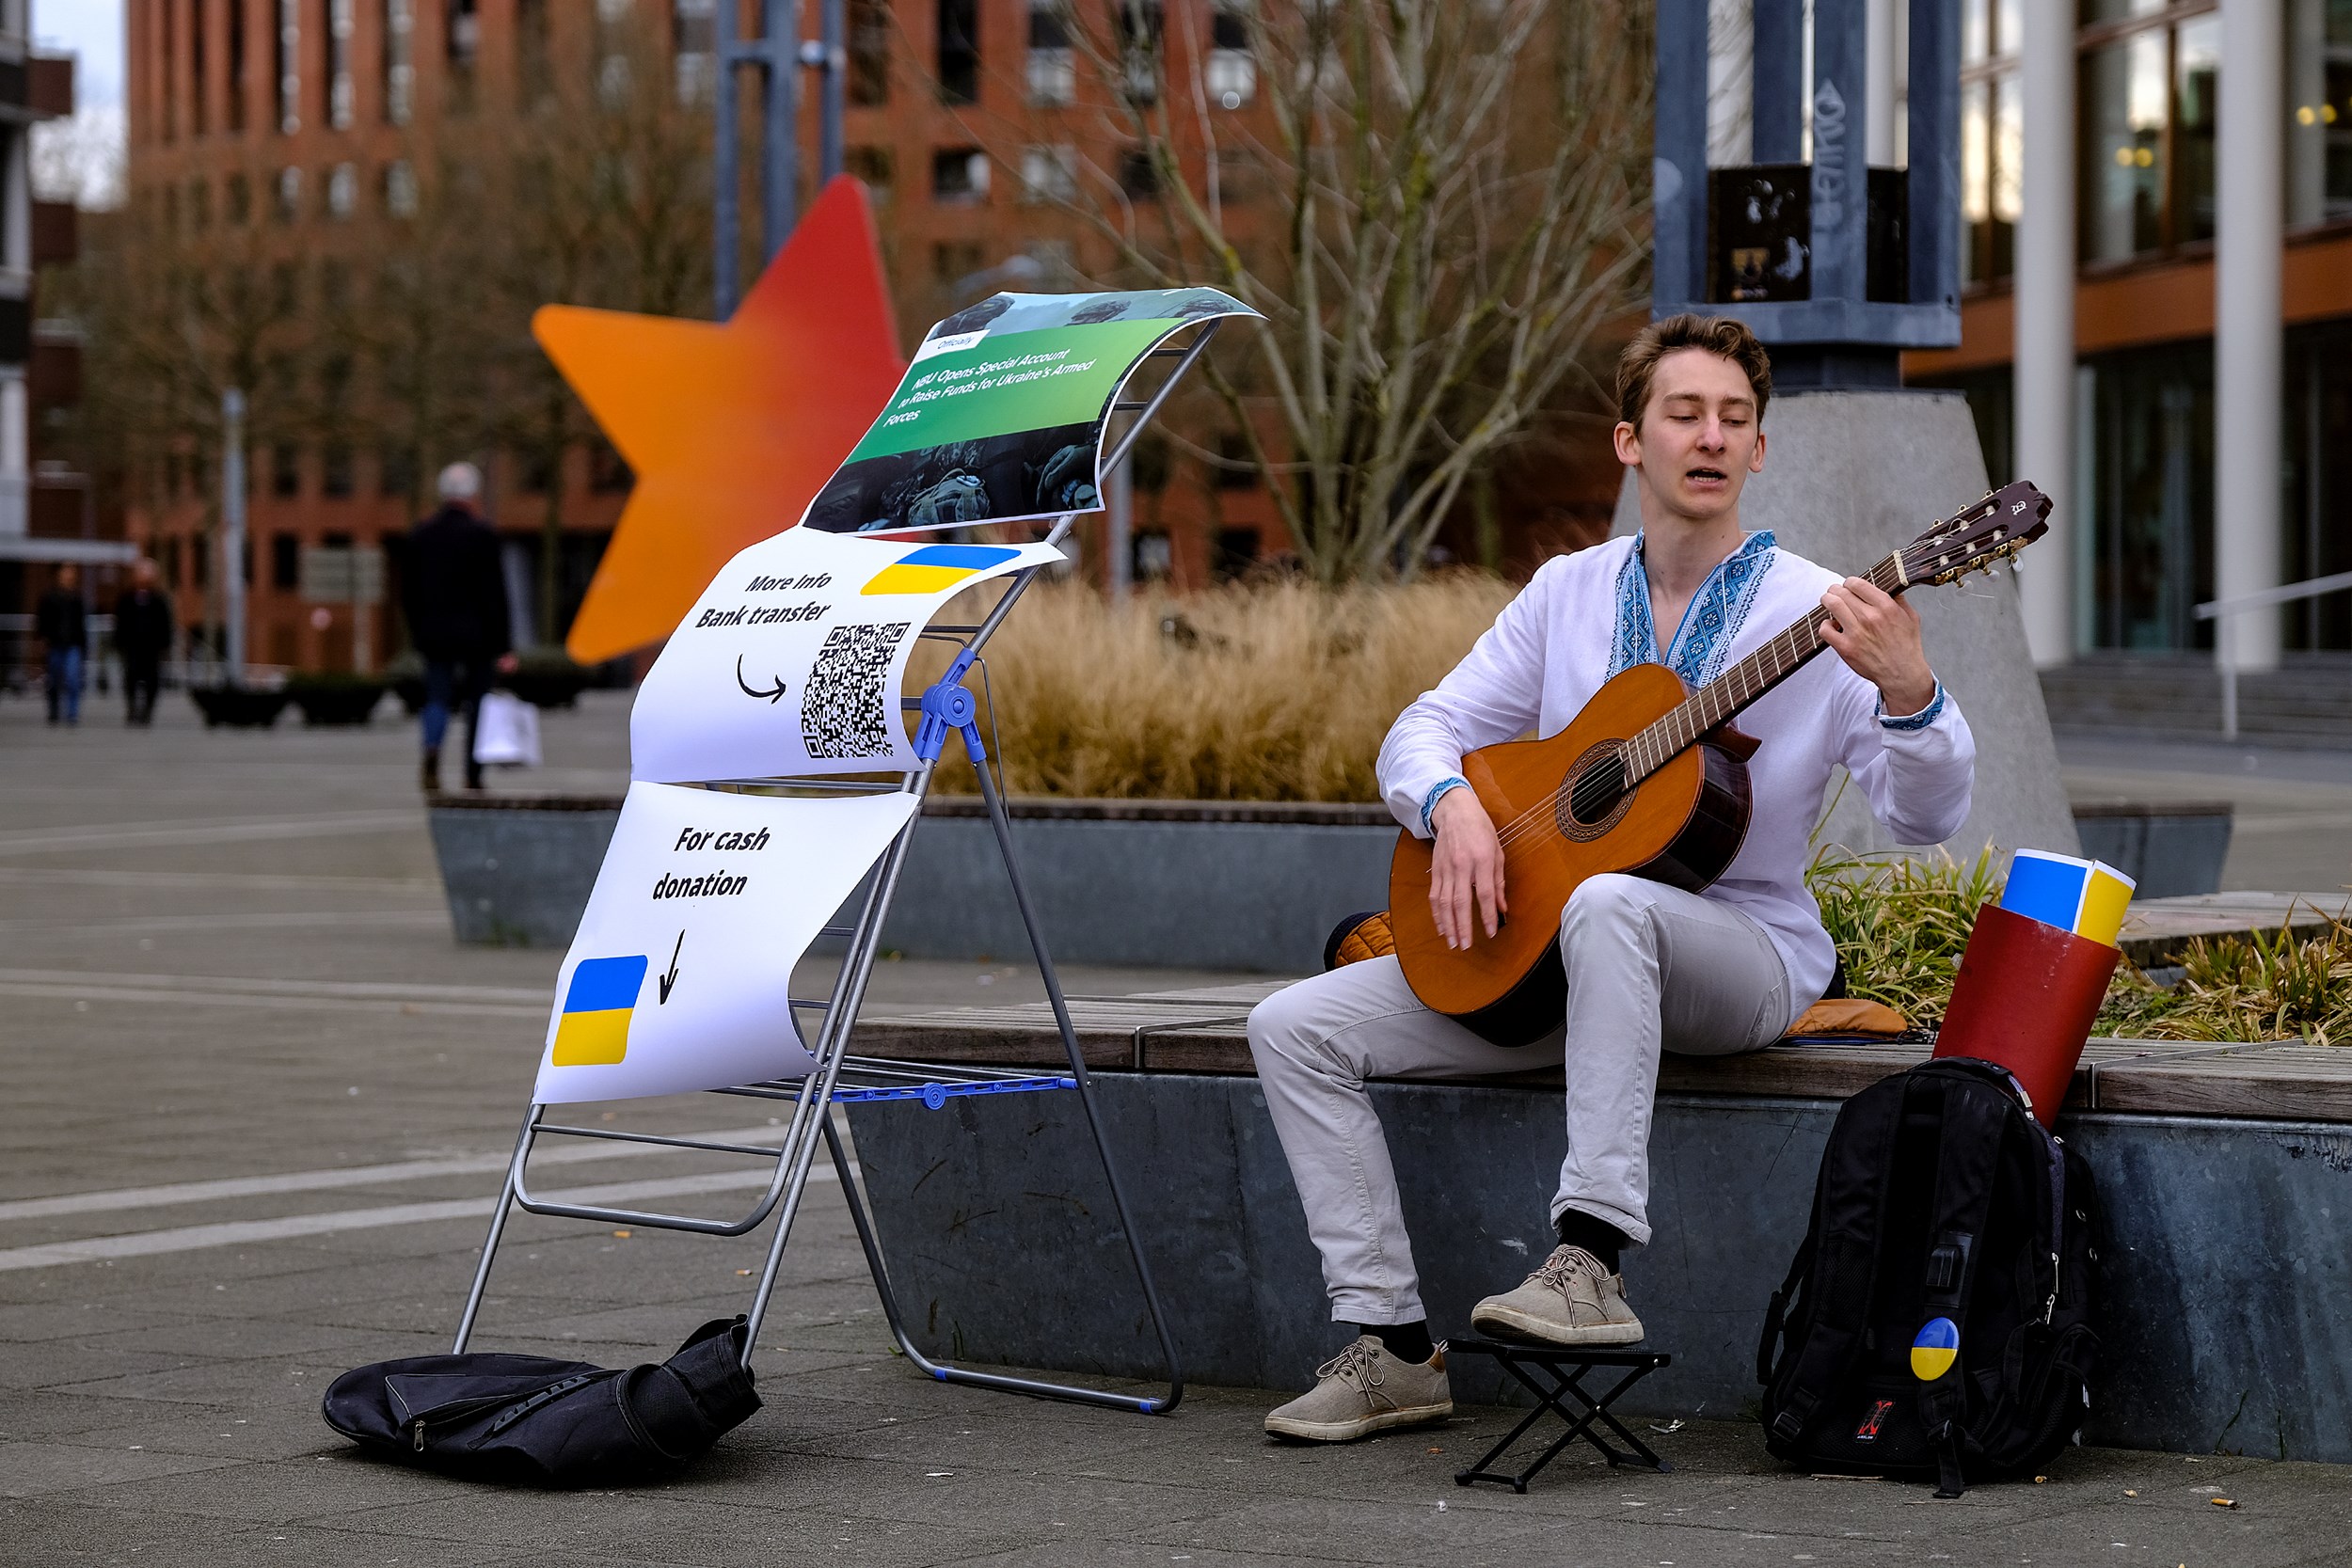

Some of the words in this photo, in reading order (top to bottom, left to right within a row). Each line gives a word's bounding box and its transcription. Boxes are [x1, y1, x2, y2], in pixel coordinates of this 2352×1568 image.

[937, 336, 974, 349] Officially
[912, 372, 938, 390] NBU
[937, 368, 976, 383] Opens
[975, 356, 1021, 375] Special
[1017, 349, 1070, 366] Account
[898, 398, 911, 409] to
[909, 388, 941, 404] Raise
[941, 381, 977, 398] Funds
[977, 378, 997, 390] for
[996, 366, 1053, 387] Ukraine's
[1050, 358, 1097, 376] Armed
[883, 410, 921, 427] Forces
[745, 575, 794, 592] More
[792, 572, 833, 590] Info
[695, 605, 749, 628] Bank
[747, 601, 832, 626] transfer
[674, 827, 715, 851] For
[714, 827, 771, 851] cash
[652, 869, 748, 900] donation
